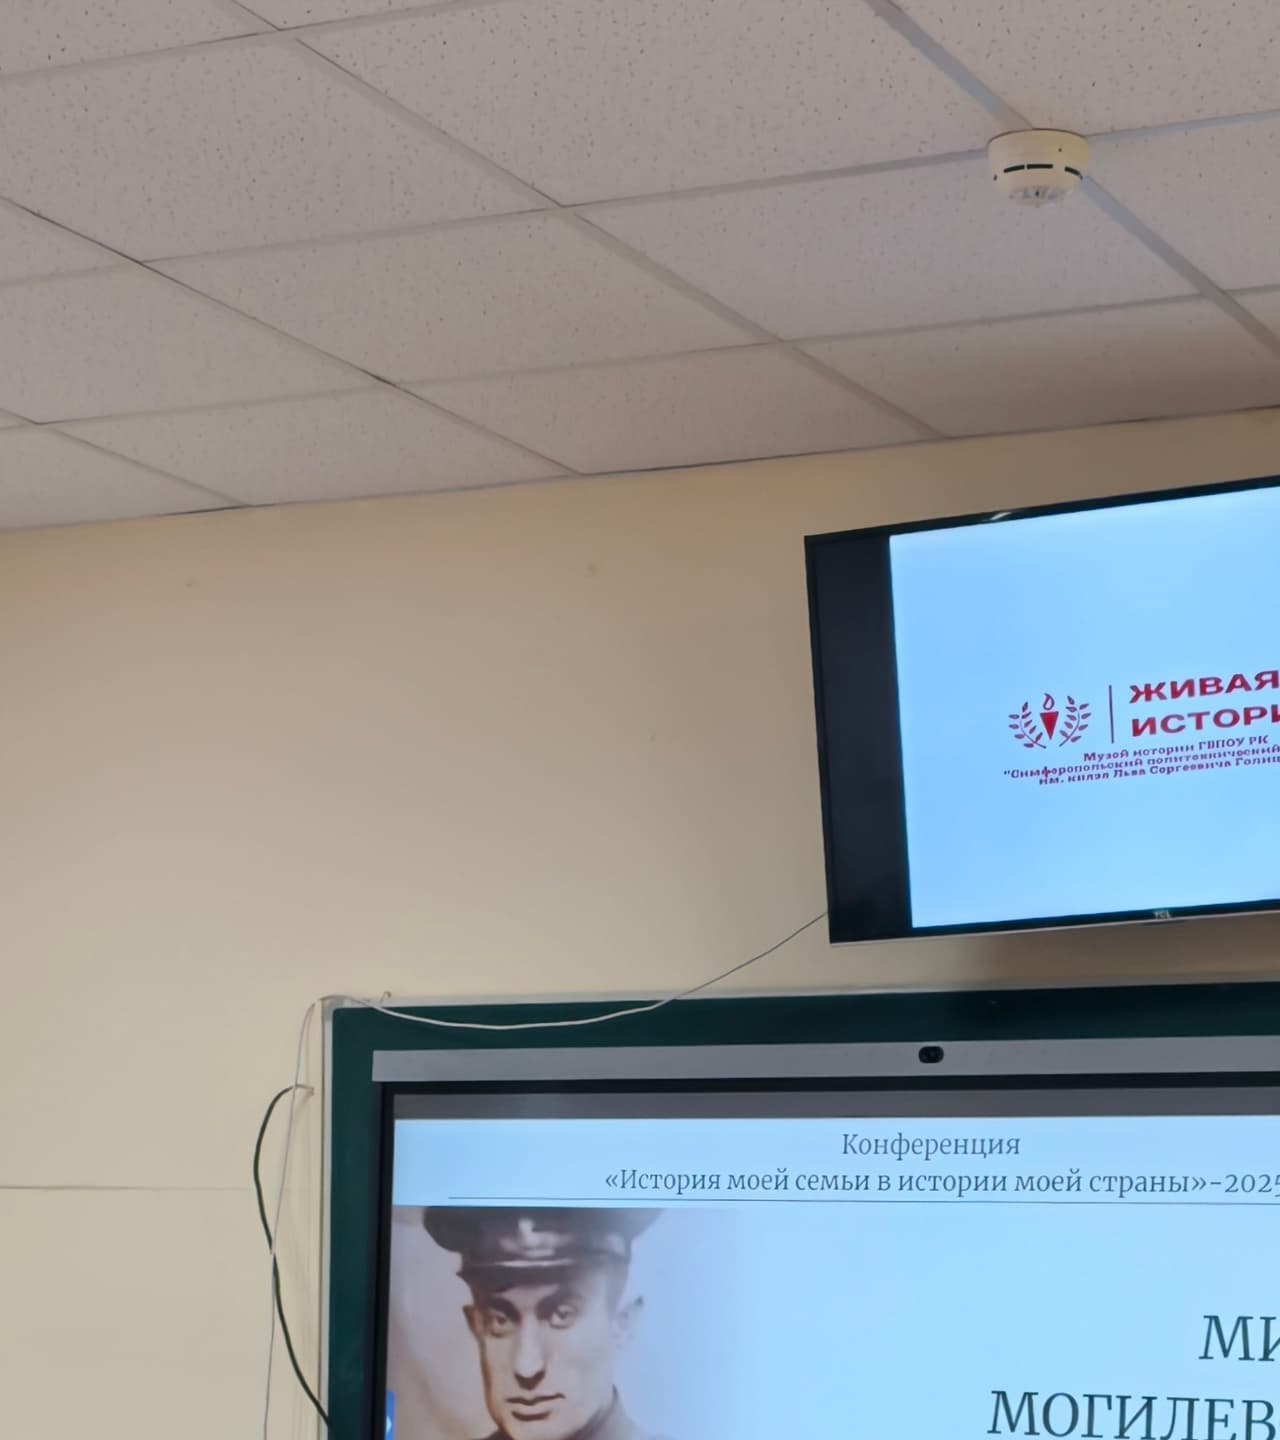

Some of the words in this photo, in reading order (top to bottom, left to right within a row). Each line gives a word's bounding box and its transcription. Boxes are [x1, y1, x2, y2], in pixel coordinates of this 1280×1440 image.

[1129, 670, 1280, 704] ЖИВАЯ
[1249, 735, 1269, 746] РК
[842, 1131, 1021, 1162] Конференция
[605, 1167, 720, 1196] «История
[726, 1167, 790, 1191] моей
[795, 1173, 869, 1192] семьи
[877, 1174, 892, 1192] в
[898, 1174, 1008, 1199] истории
[1014, 1168, 1082, 1193] моей
